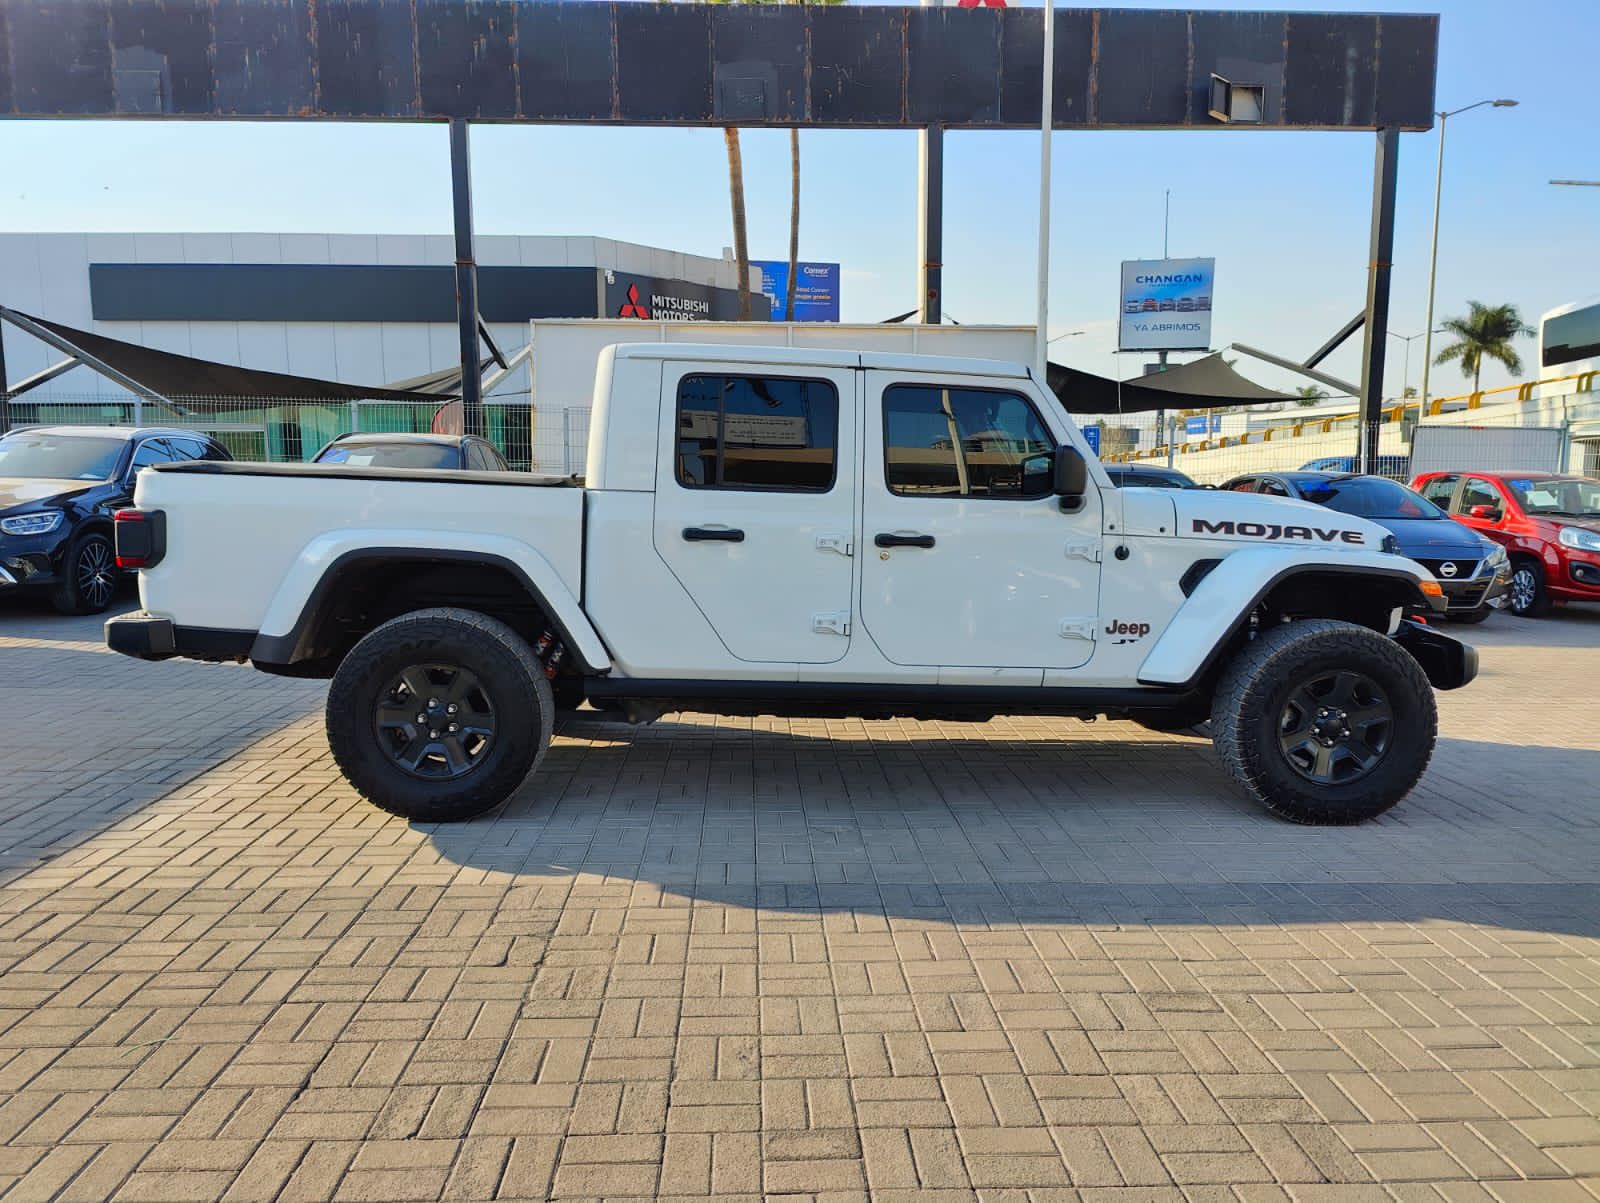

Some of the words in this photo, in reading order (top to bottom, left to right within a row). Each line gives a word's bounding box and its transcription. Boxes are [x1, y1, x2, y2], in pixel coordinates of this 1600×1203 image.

[1135, 273, 1203, 284] CHANGAN
[651, 294, 709, 313] MITSUBISHI
[1134, 323, 1149, 332] YA
[1151, 322, 1201, 332] ABRIMOS
[1192, 518, 1365, 545] MOJAVE
[1105, 619, 1150, 638] Jeep
